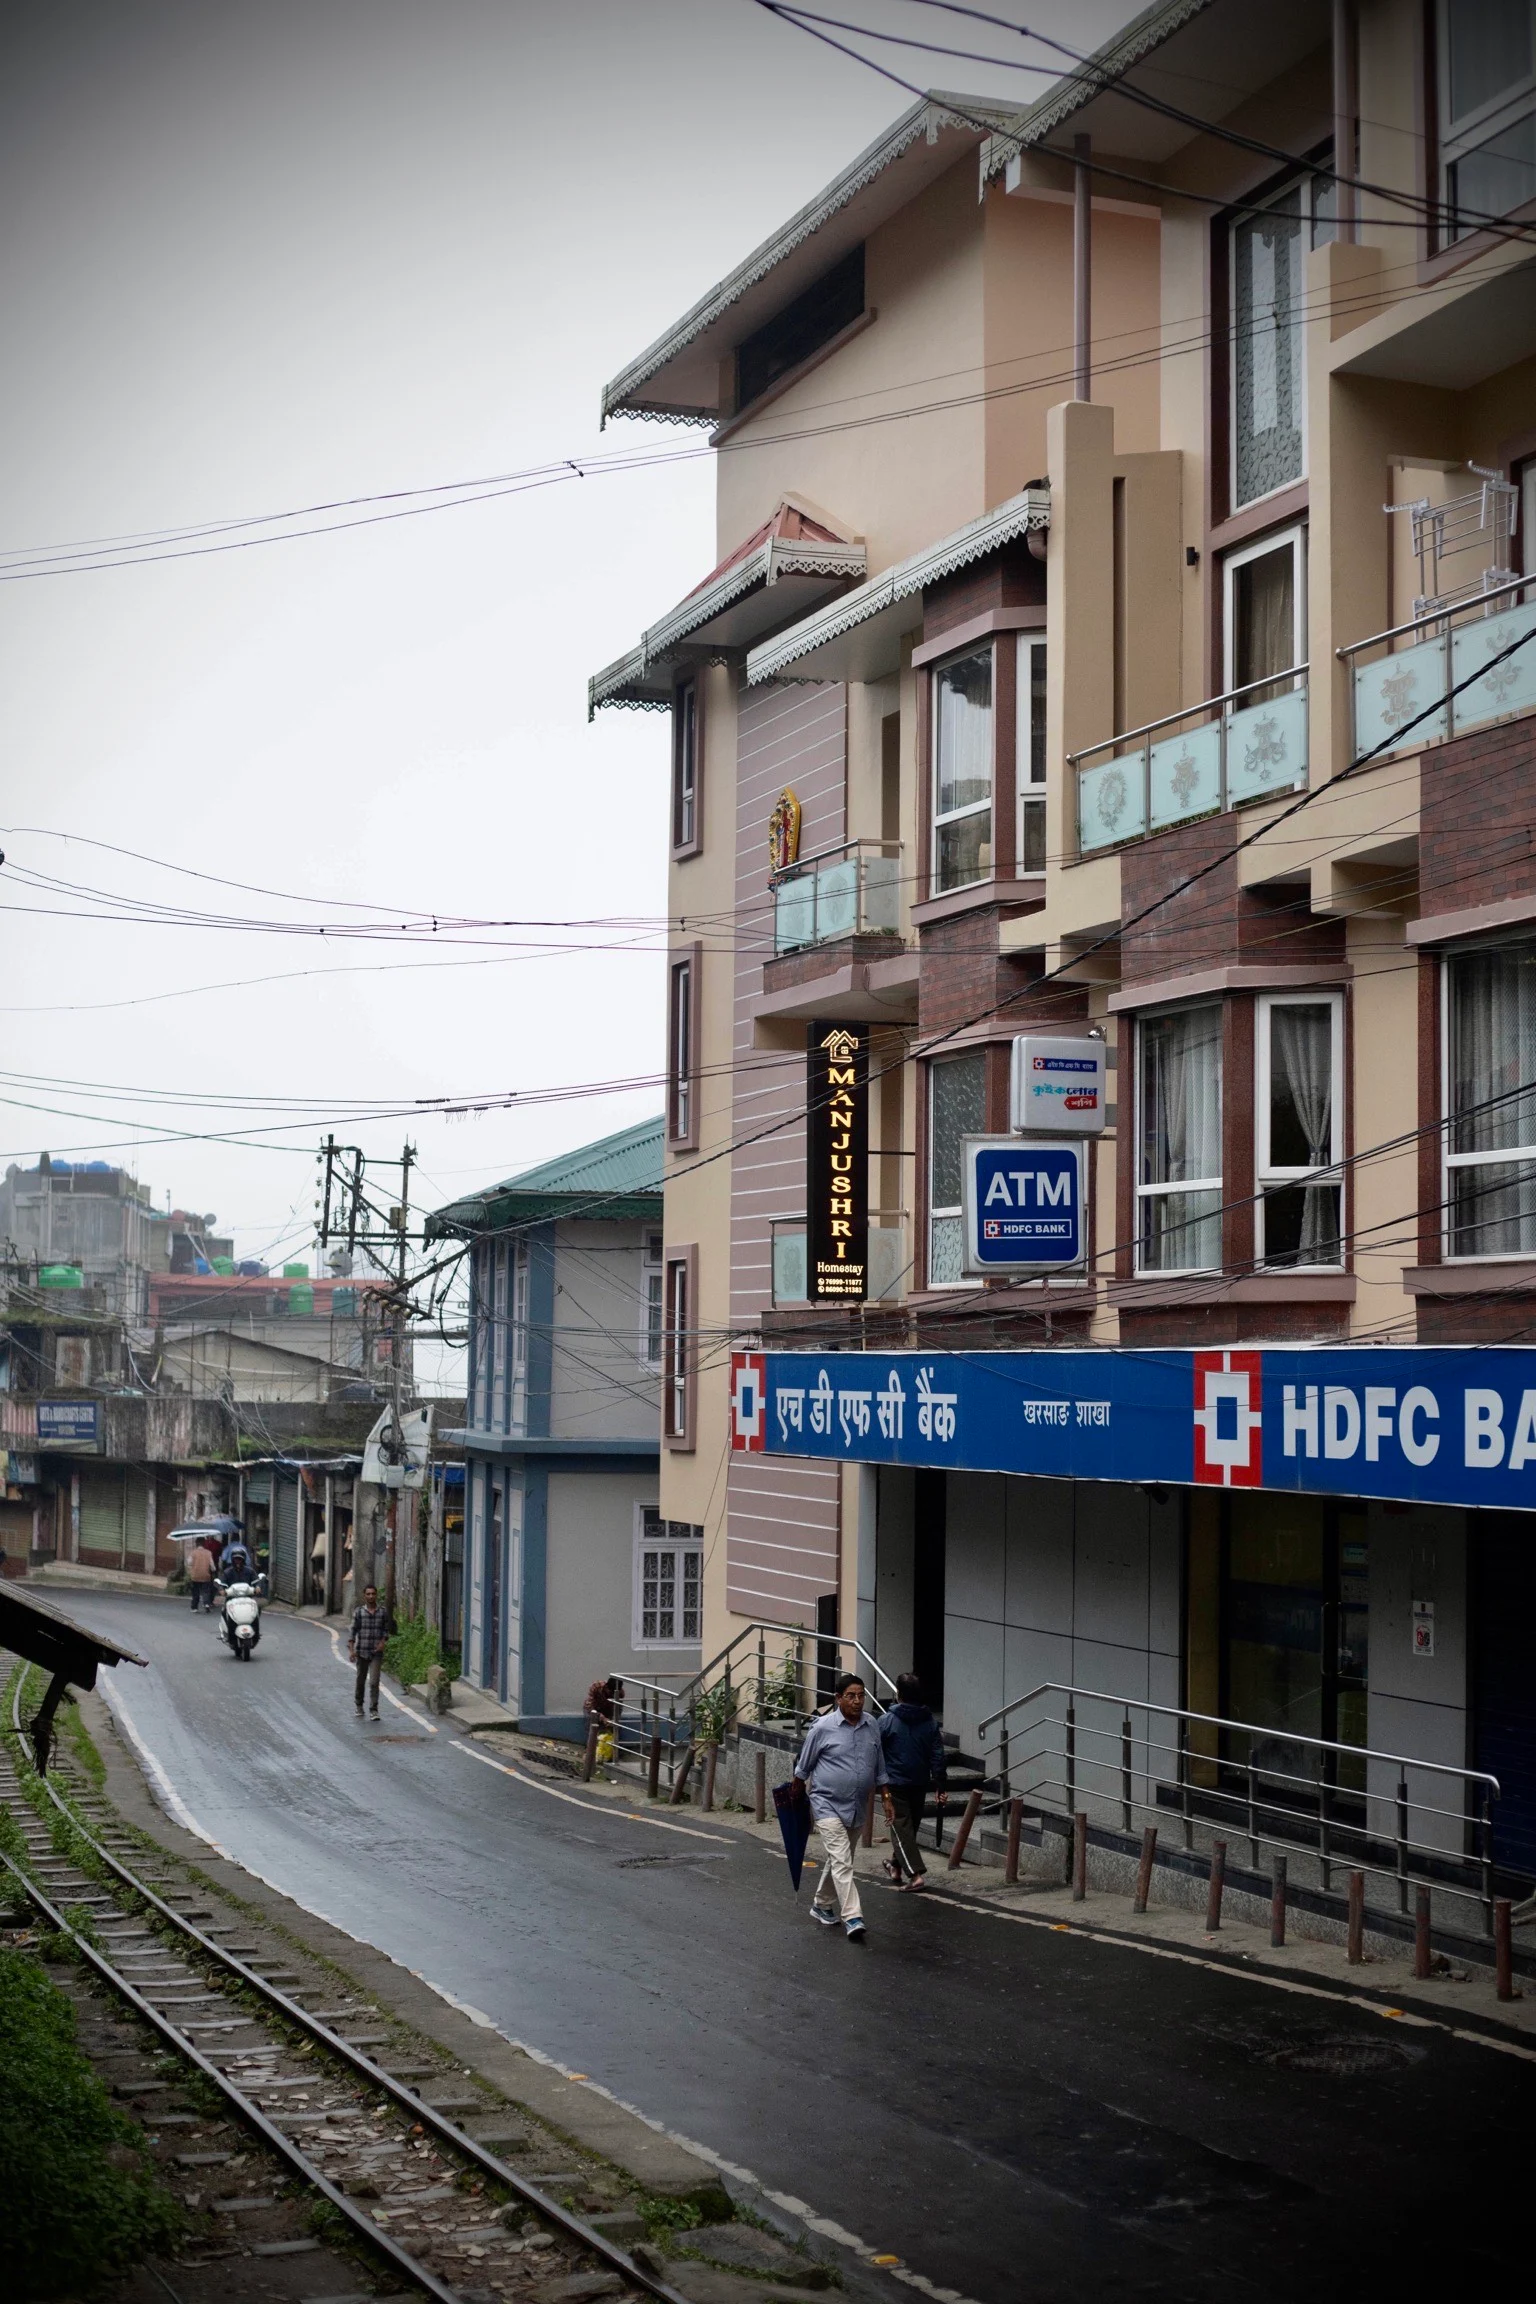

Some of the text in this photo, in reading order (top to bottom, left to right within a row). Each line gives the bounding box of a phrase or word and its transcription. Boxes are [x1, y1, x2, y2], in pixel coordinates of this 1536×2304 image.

[828, 1067, 856, 1259] MANJUSHRI
[984, 1172, 1071, 1206] ATM
[1004, 1224, 1066, 1234] HDFC BANK
[817, 1261, 864, 1276] Homestay
[915, 1367, 958, 1442] बैंक
[1075, 1401, 1111, 1428] शाखा
[1283, 1385, 1441, 1467] HDFC
